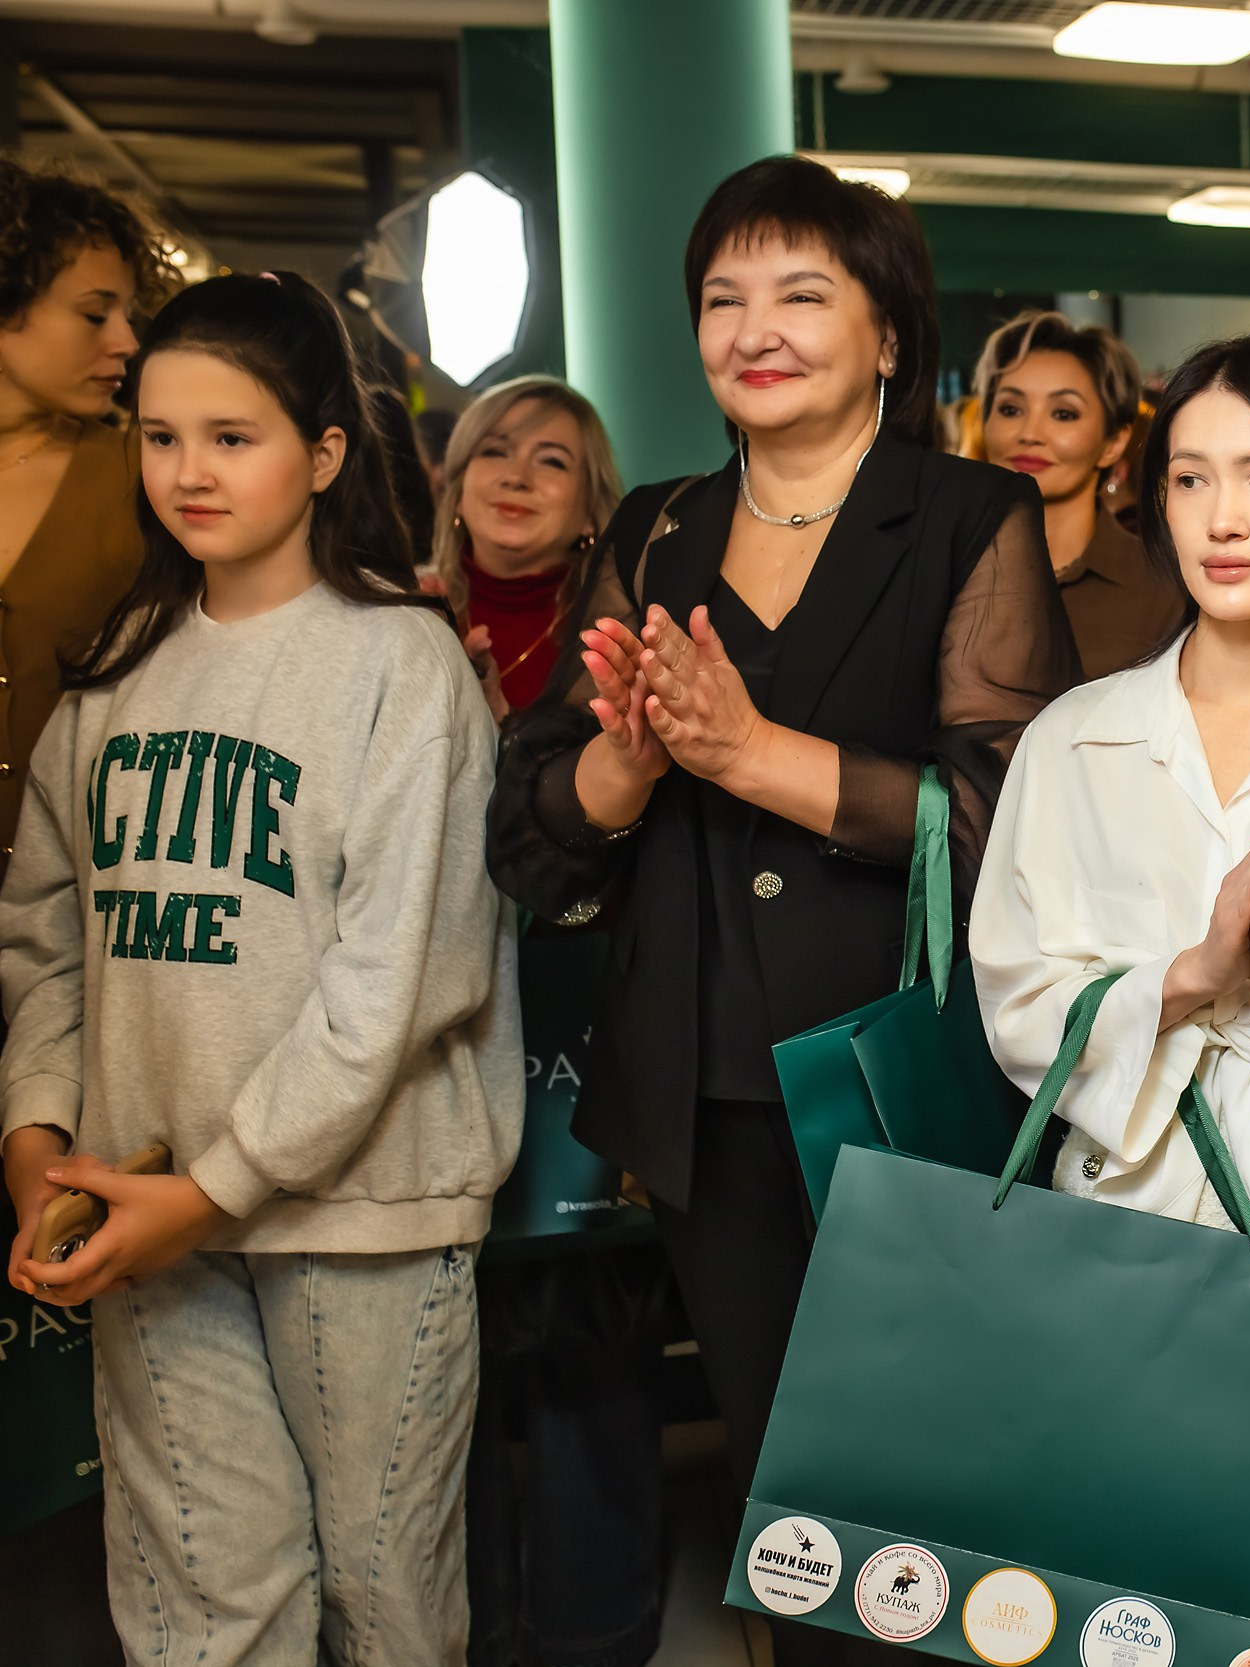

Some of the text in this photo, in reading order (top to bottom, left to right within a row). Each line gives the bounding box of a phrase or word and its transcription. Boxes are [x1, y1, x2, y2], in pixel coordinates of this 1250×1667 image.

[87, 730, 302, 899] CTIVE
[93, 890, 242, 965] TIME
[757, 1547, 834, 1577] ХОЧУ И БУДЕТ
[866, 1564, 878, 1579] чай
[884, 1550, 906, 1561] кофе
[908, 1551, 918, 1559] со
[919, 1556, 937, 1575] всего
[934, 1576, 942, 1598] мира
[754, 1565, 830, 1588] волшебная карта желаний
[876, 1592, 921, 1613] КУПАЖ
[992, 1602, 1028, 1620] АИФ
[972, 1617, 1043, 1638] COSMETICS
[1117, 1609, 1151, 1629] ГРАФ
[1099, 1619, 1161, 1648] НОСКОВ
